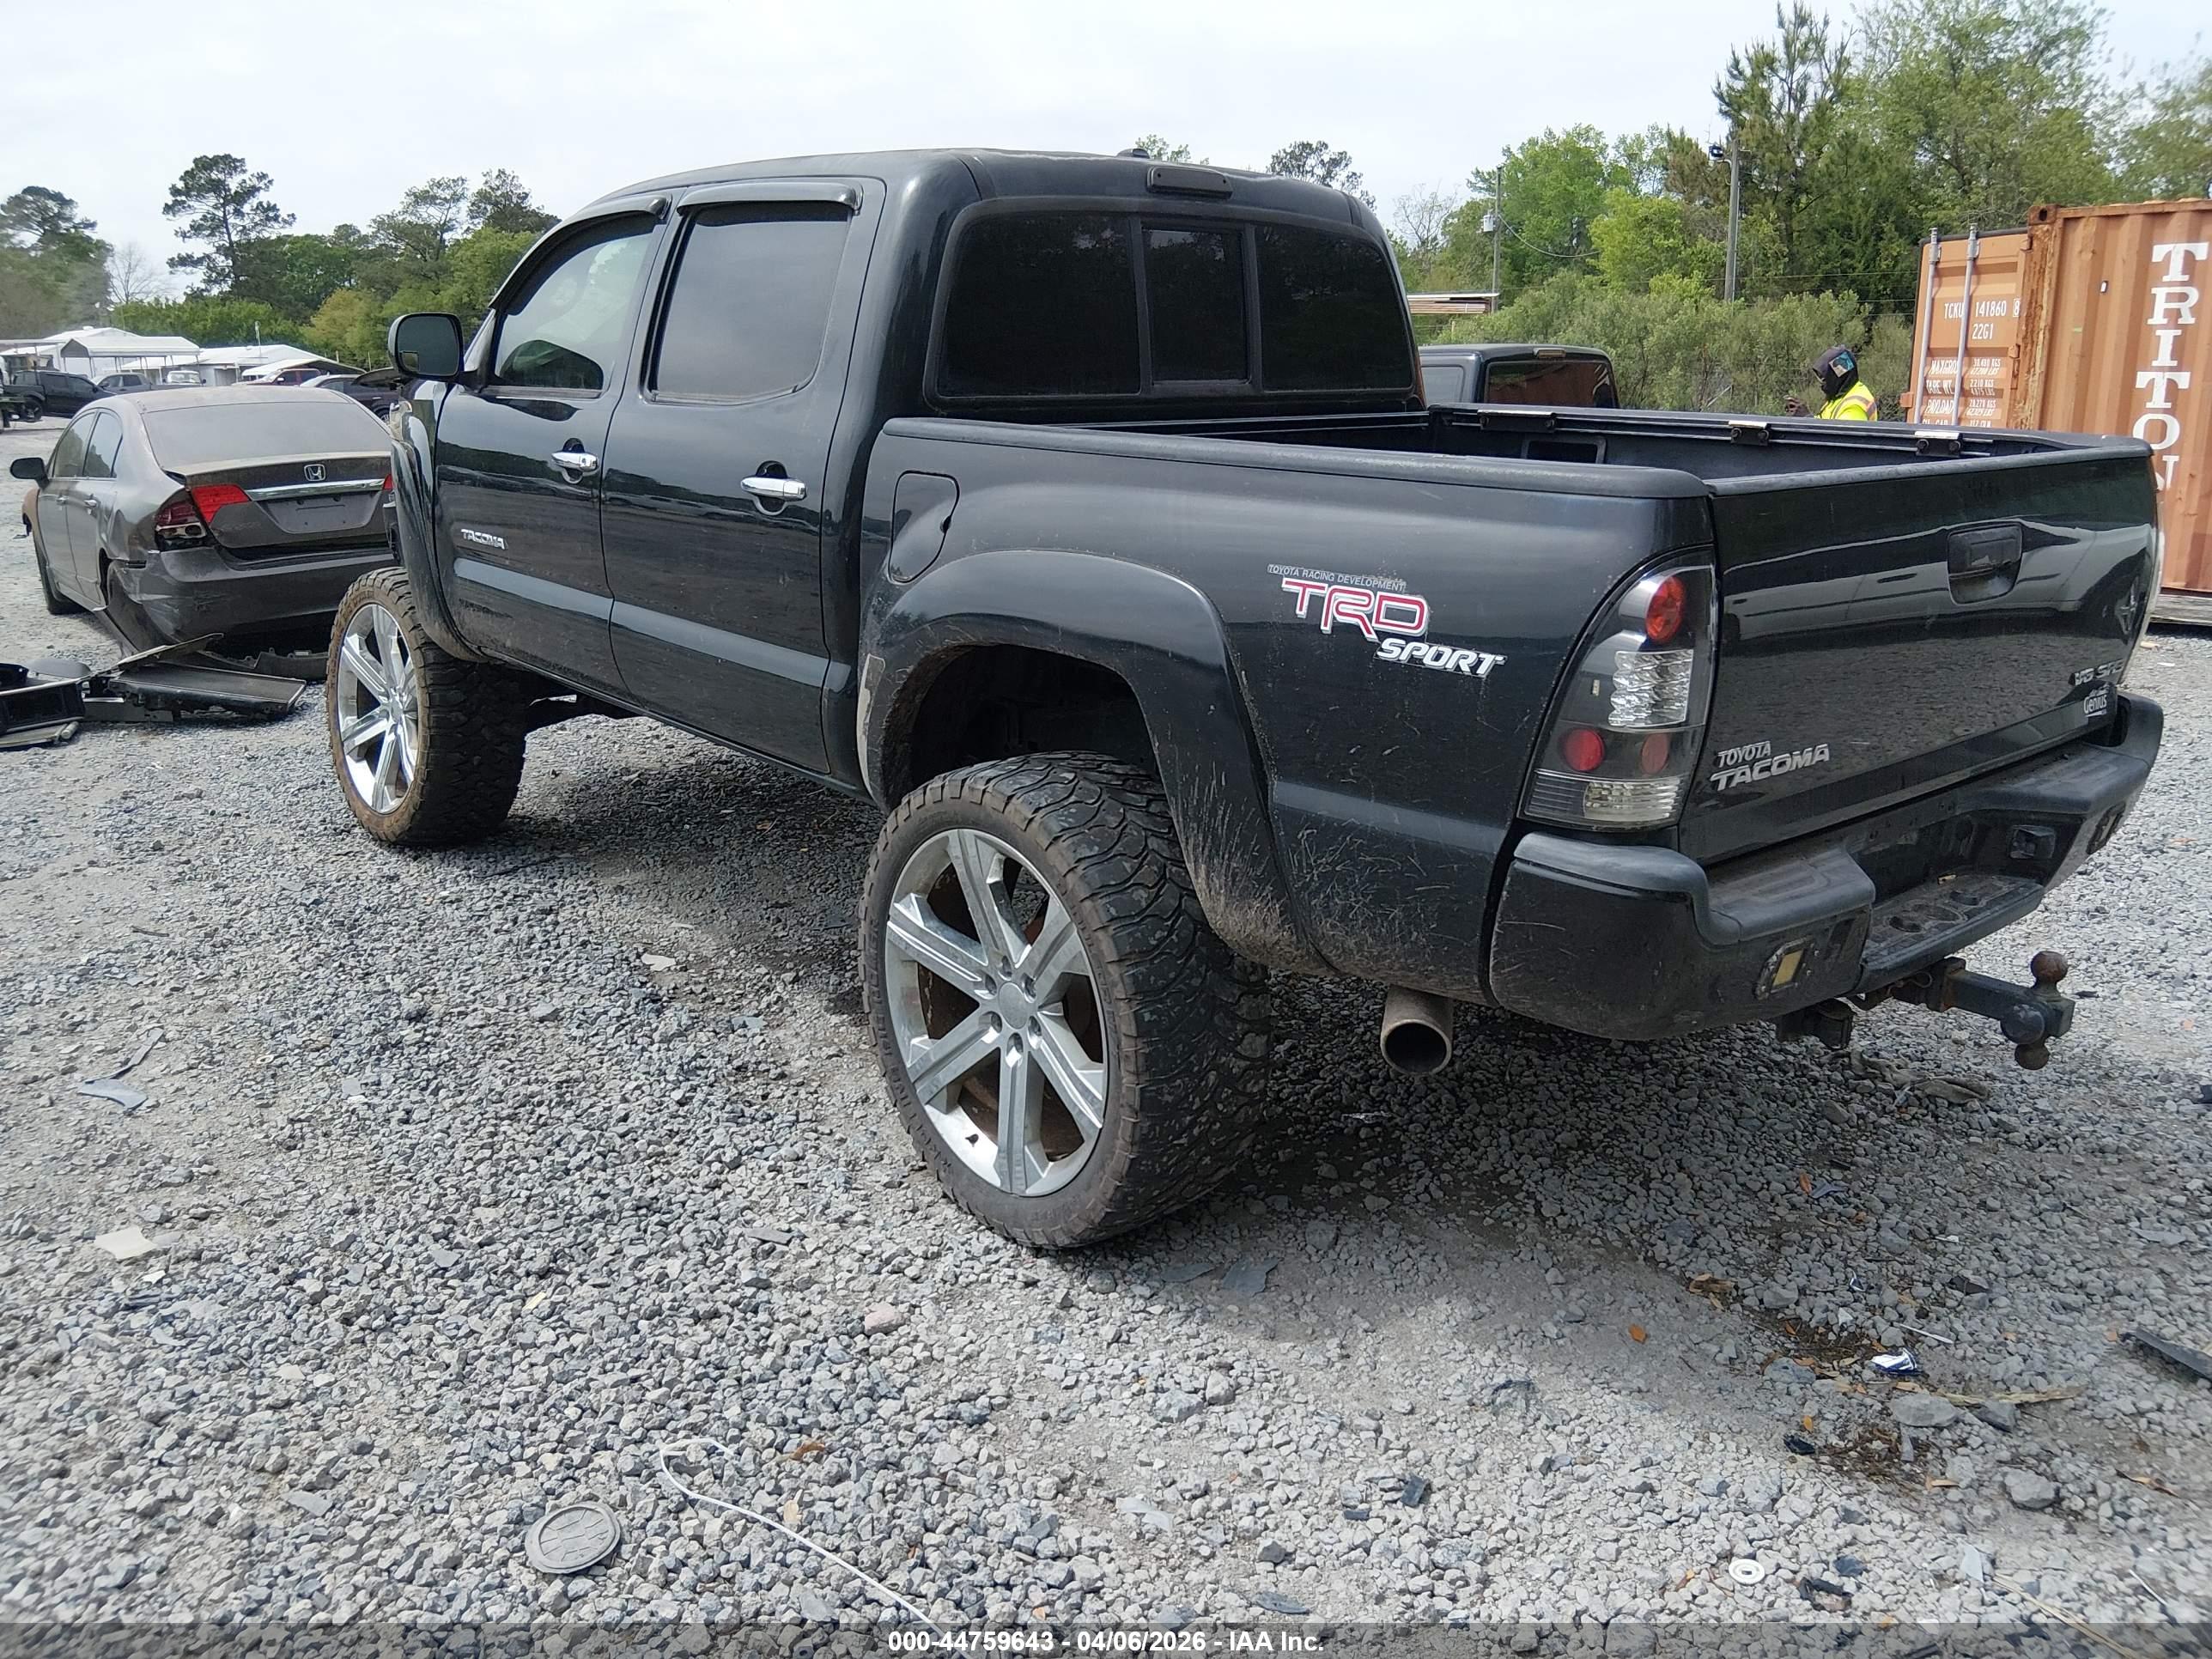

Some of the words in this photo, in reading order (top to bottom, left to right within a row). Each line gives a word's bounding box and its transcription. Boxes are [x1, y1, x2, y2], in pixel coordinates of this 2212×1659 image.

[1944, 301, 1965, 319] TCKU
[1975, 301, 2007, 318] 141860
[2013, 299, 2021, 317] 8
[1972, 323, 1993, 340] 22G1
[2132, 242, 2209, 491] TRITON
[461, 528, 506, 550] TACOMA
[1267, 563, 1300, 577] TOYOTA
[1302, 569, 1335, 583] RACING
[1337, 574, 1406, 592] DEVELOPMENT
[1281, 577, 1429, 643] TRD
[1376, 637, 1508, 678] SPORT
[1710, 743, 1830, 791] TACOMA
[1717, 740, 1771, 768] TOYOTA
